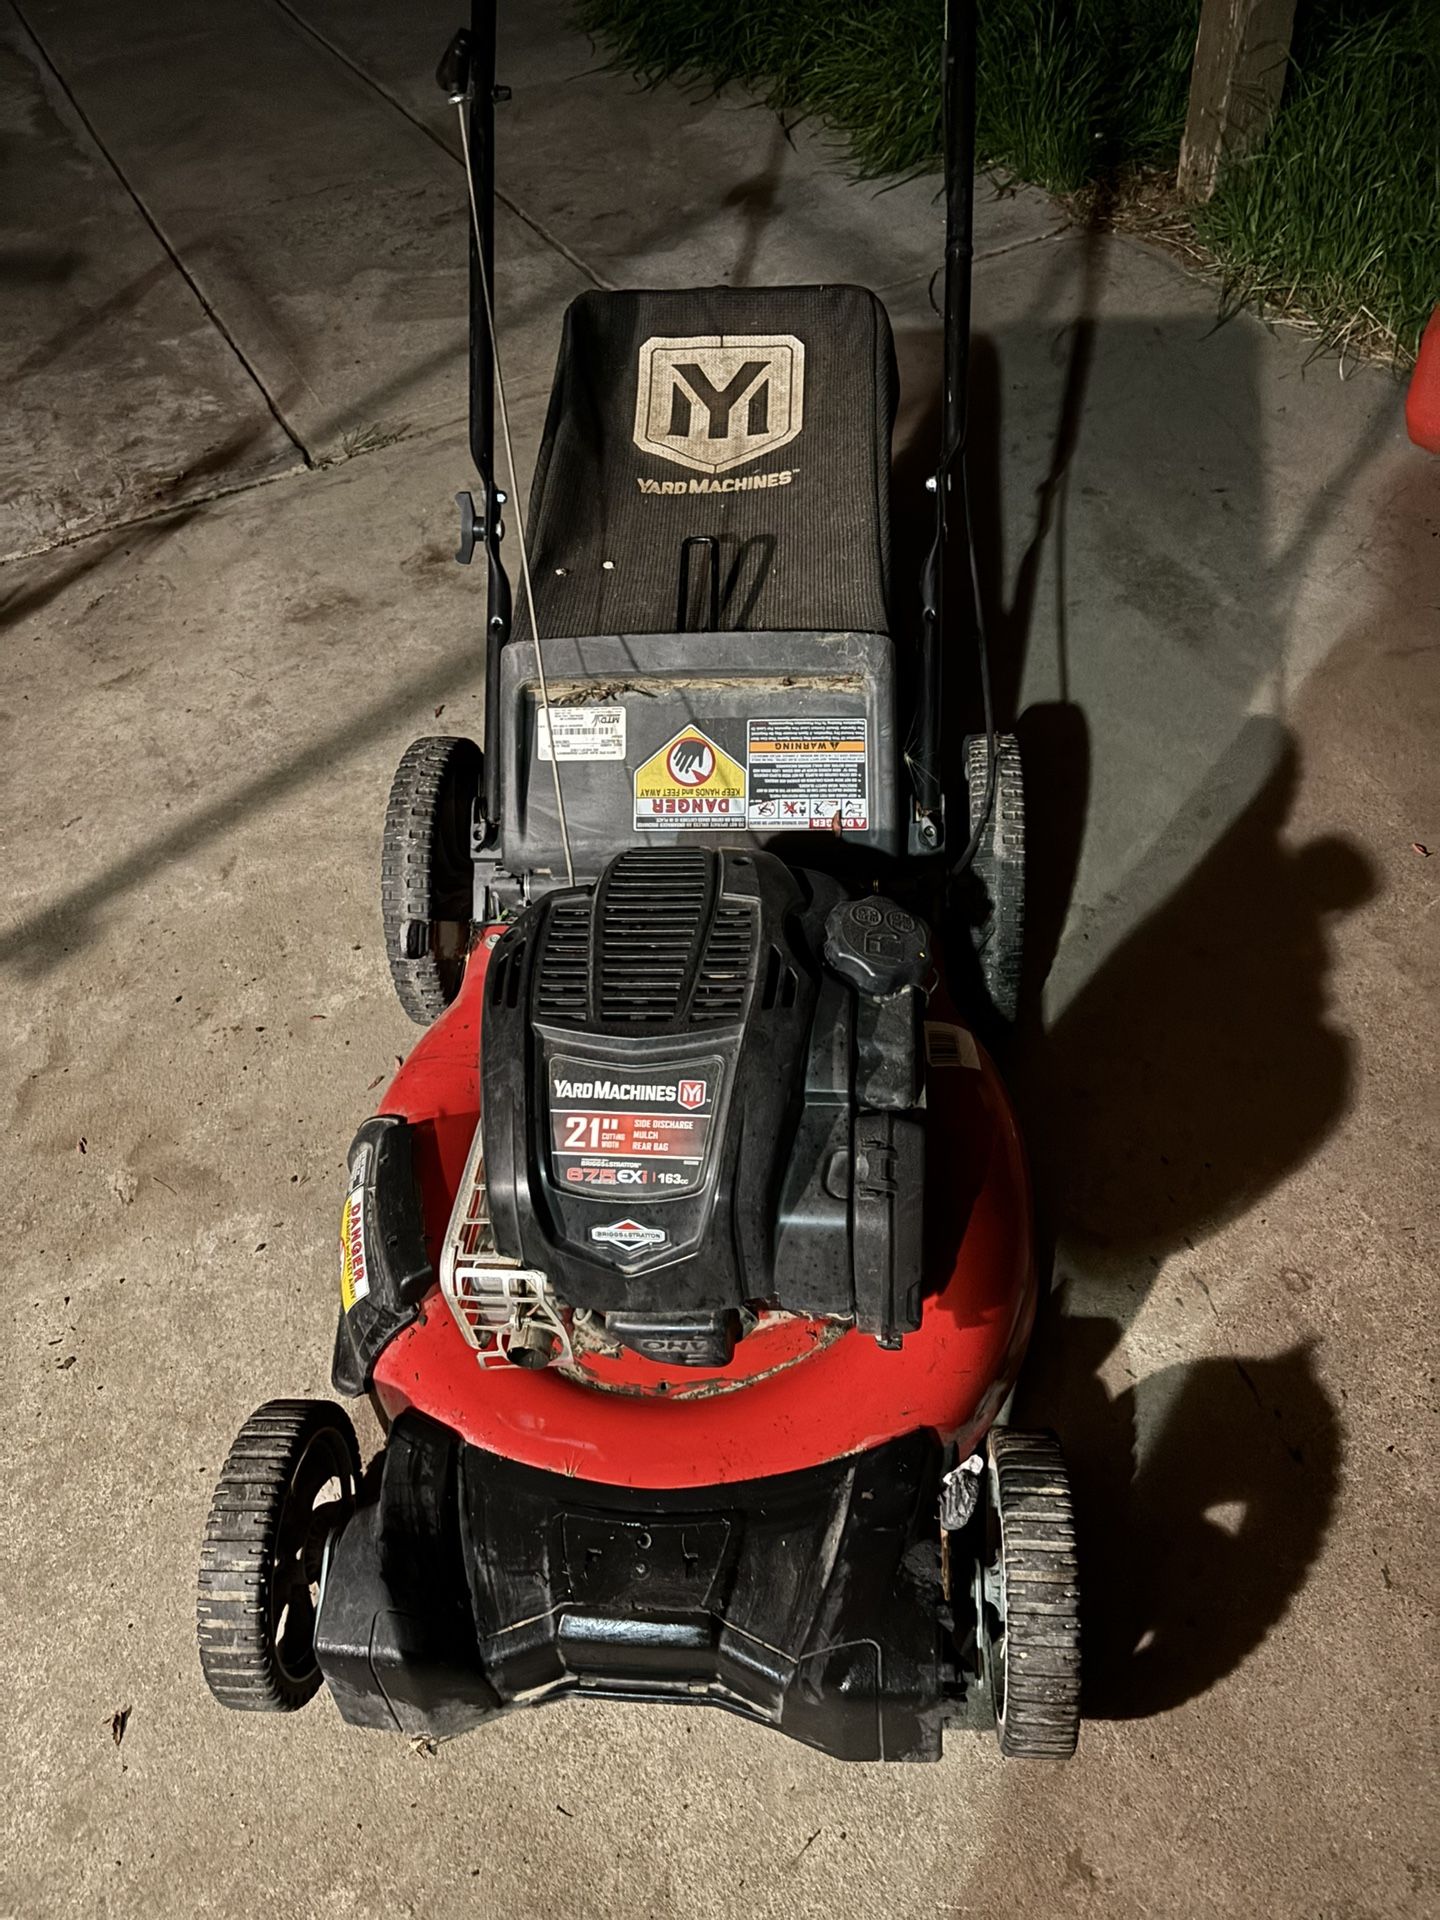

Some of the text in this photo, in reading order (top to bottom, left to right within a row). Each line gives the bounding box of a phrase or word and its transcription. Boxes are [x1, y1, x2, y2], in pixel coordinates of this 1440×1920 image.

[637, 471, 793, 494] YARD MACHINES
[774, 742, 827, 750] WARNING
[640, 788, 741, 797] KEEP HANDS and FEET AWAY
[652, 798, 730, 813] DANGER
[812, 818, 854, 827] DAGER
[554, 1080, 594, 1098] YARD
[594, 1081, 676, 1102] MACHINES
[634, 1120, 694, 1130] SIDE DISCHARGE
[633, 1131, 659, 1140] MULCH
[632, 1142, 669, 1151] REAR BAG
[350, 1202, 365, 1283] DANGER
